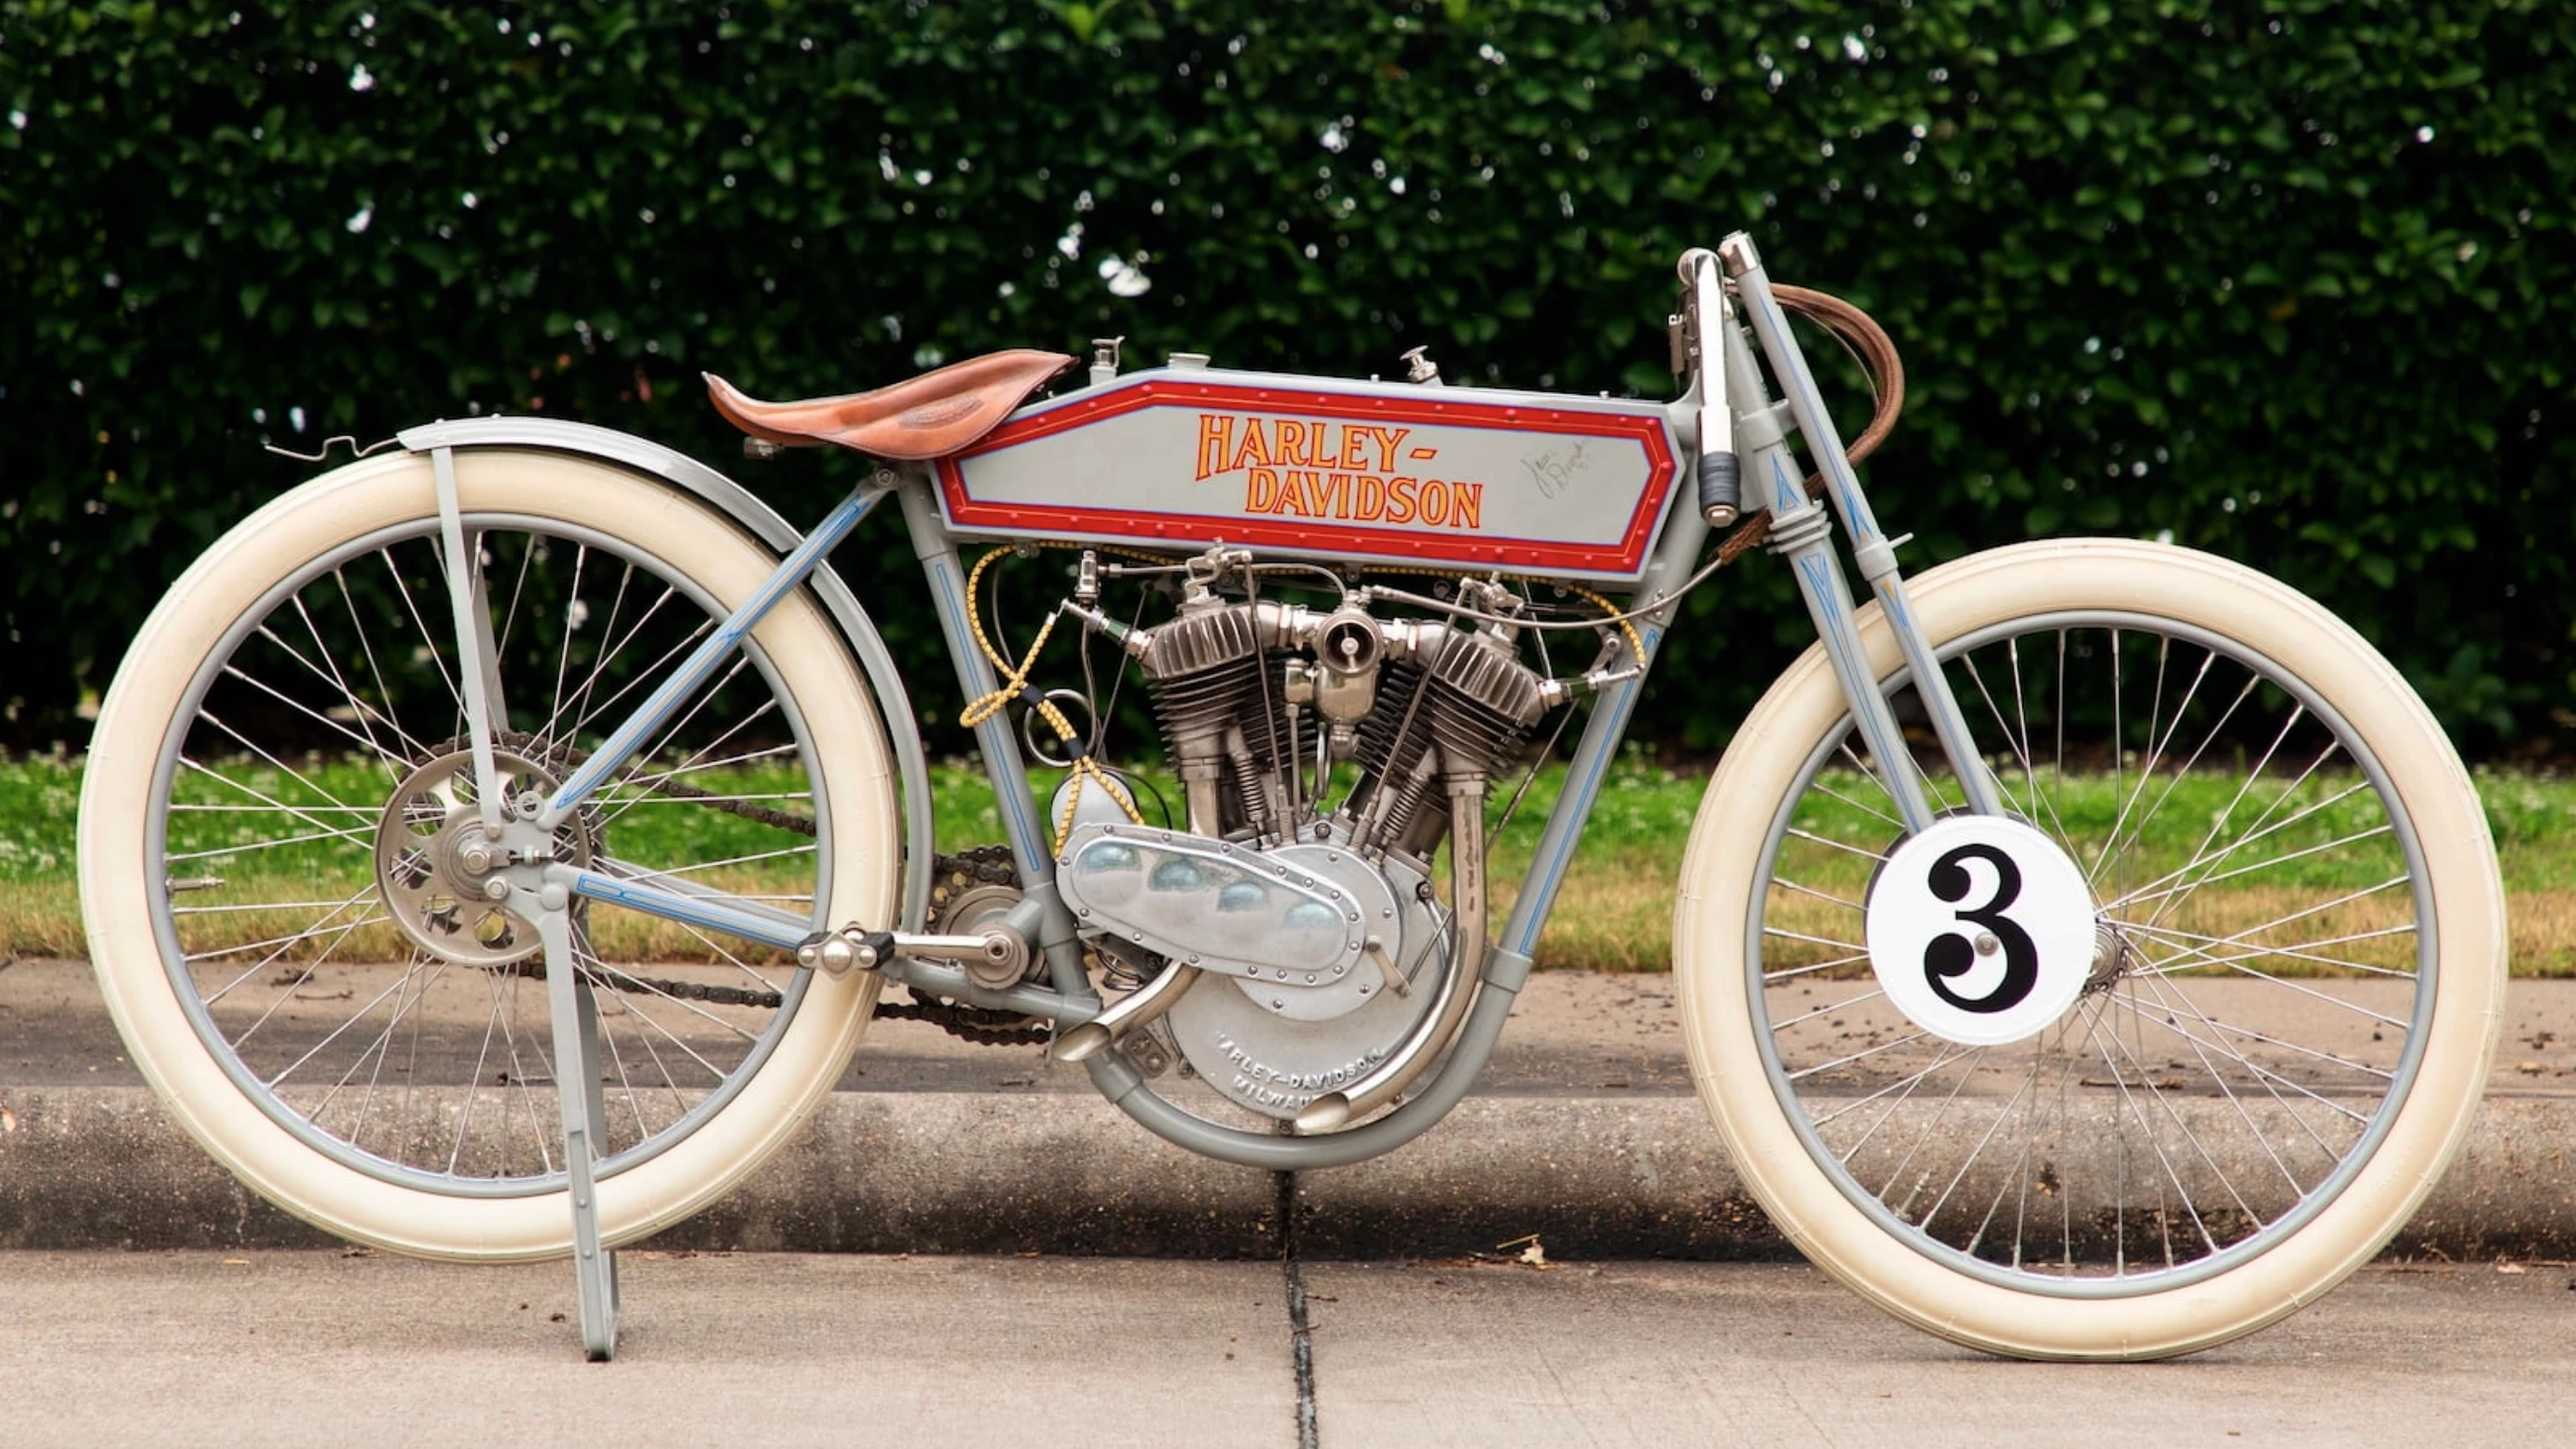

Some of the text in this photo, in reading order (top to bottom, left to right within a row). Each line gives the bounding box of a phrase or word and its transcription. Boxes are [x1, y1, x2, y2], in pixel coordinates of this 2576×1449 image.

[1195, 414, 1438, 481] HARLEY-
[1245, 467, 1484, 529] DAVIDSON
[1924, 843, 2038, 1014] 3
